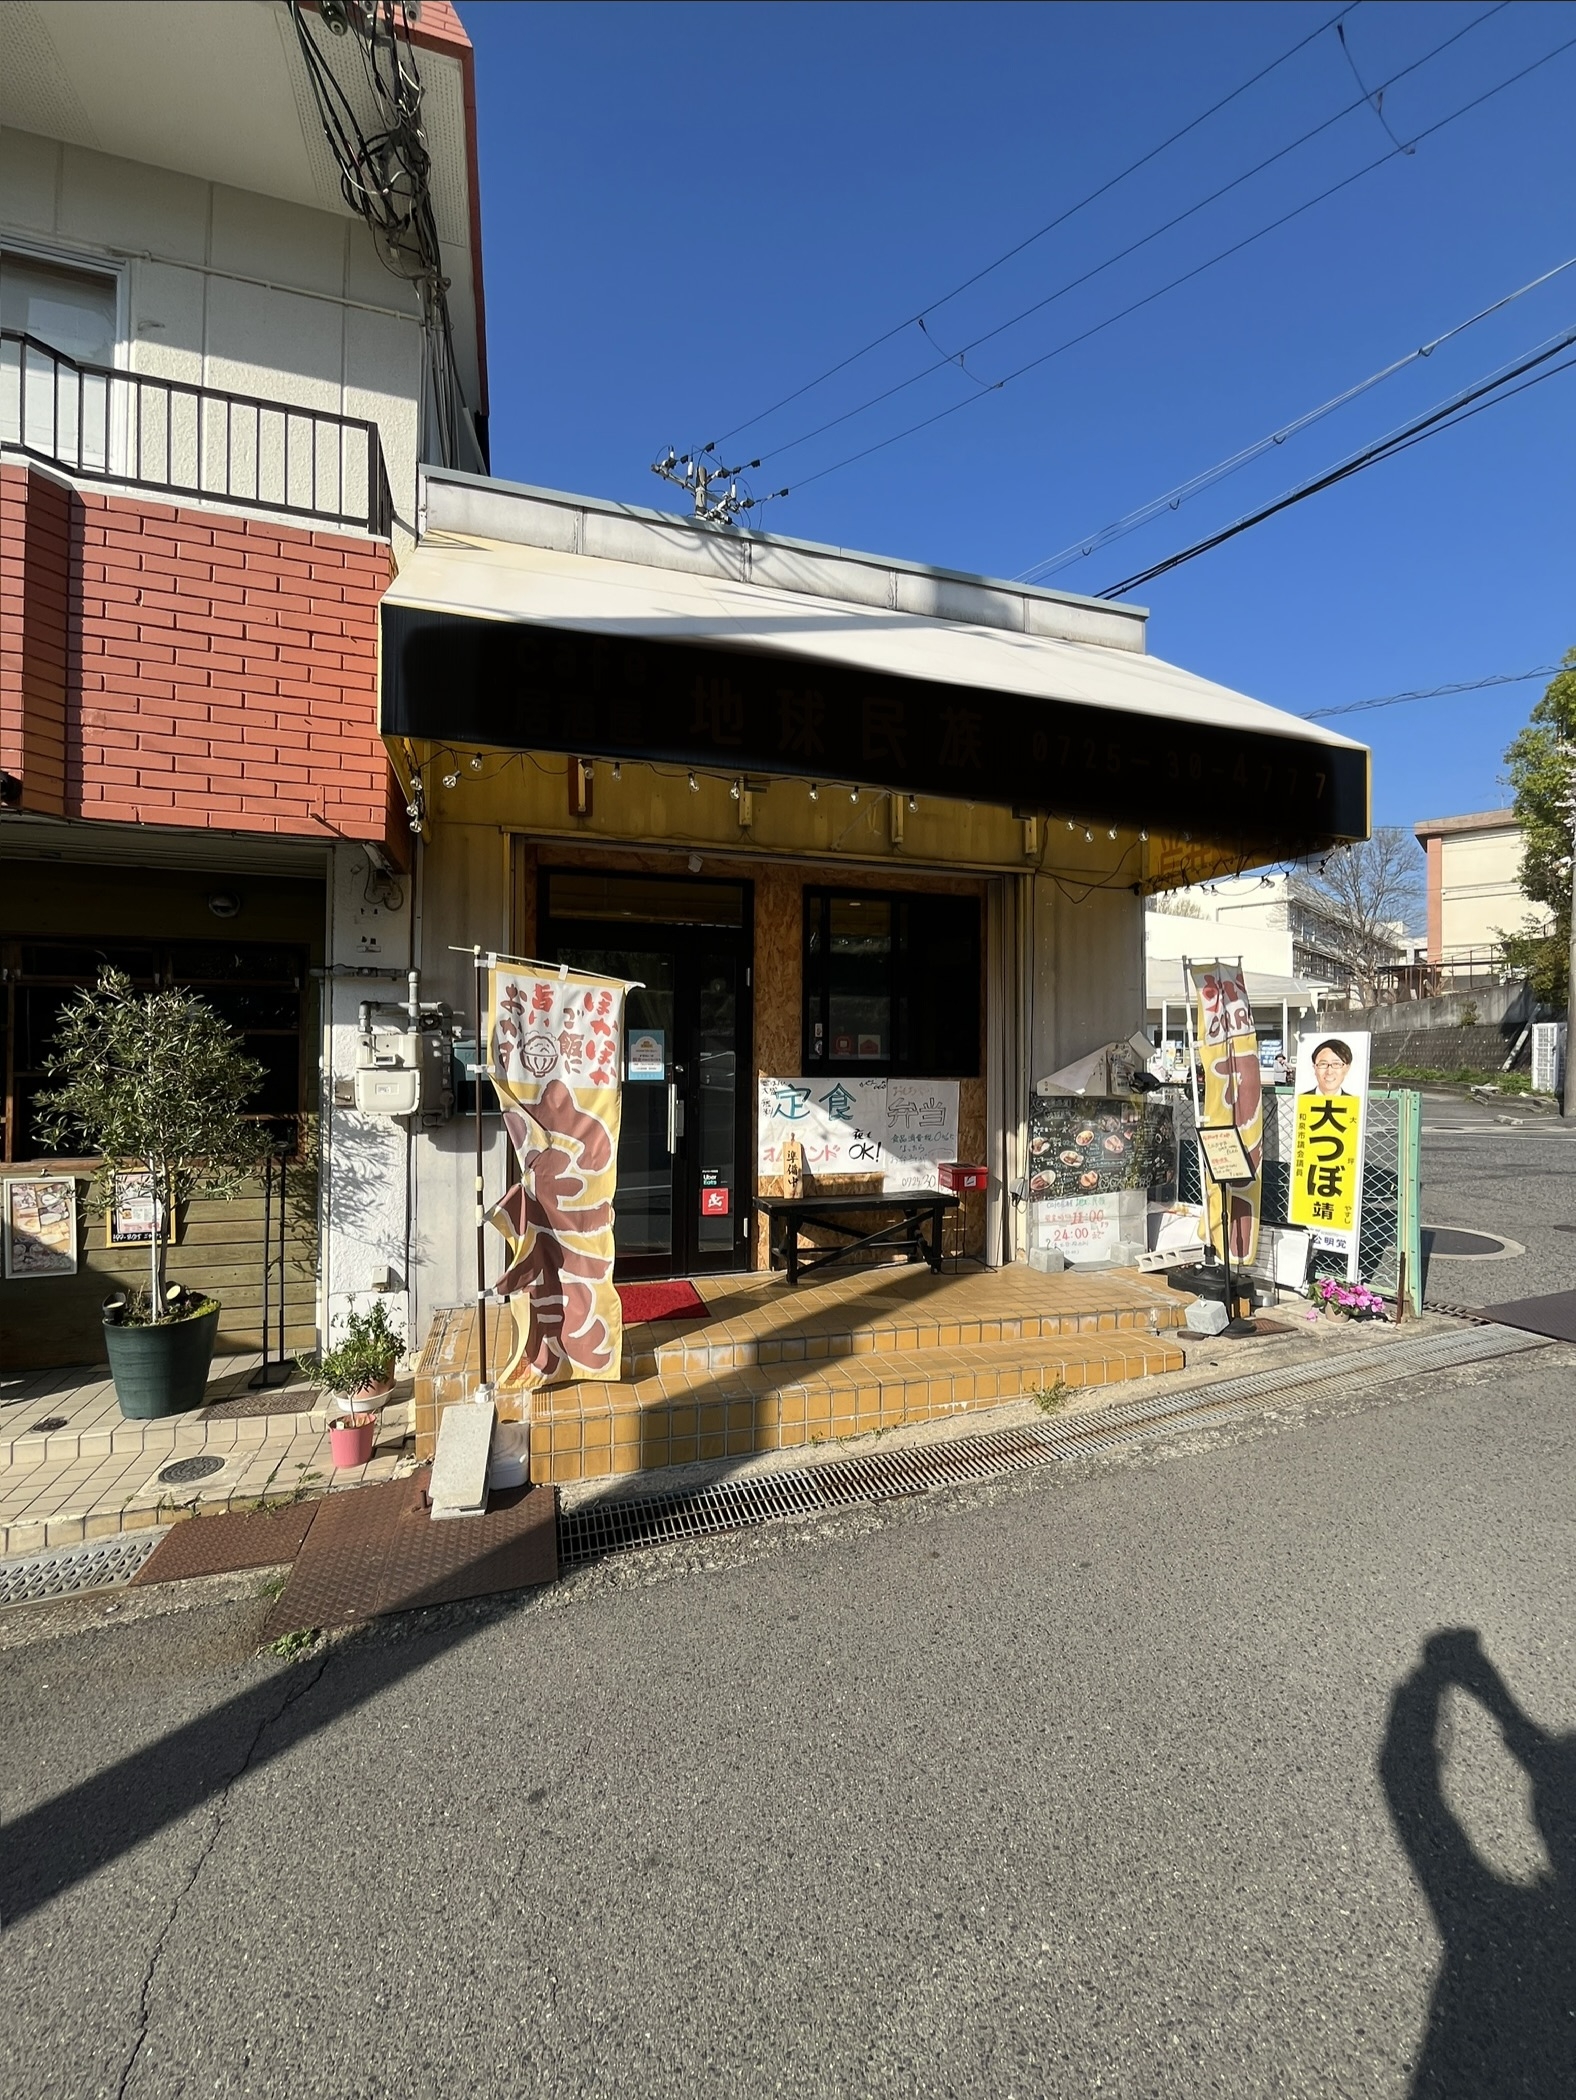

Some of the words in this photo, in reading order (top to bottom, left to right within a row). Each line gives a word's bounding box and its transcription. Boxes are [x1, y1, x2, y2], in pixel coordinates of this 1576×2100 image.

[689, 674, 984, 768] 地球民族
[528, 983, 554, 1028] 旨い
[498, 984, 524, 1072] おかず
[557, 1008, 585, 1074] ご飯に
[583, 991, 618, 1086] ほかほか
[772, 1083, 857, 1120] 定食
[887, 1097, 946, 1129] 弁当
[848, 1141, 882, 1163] OK!
[1296, 1113, 1307, 1177] 和泉市議会議員
[1305, 1100, 1347, 1197] 大つぼ
[786, 1150, 800, 1188] 準備中
[1070, 1209, 1104, 1225] 11:00
[1312, 1201, 1334, 1220] 靖
[1054, 1228, 1089, 1241] 24:00
[1313, 1234, 1347, 1249] 公明党
